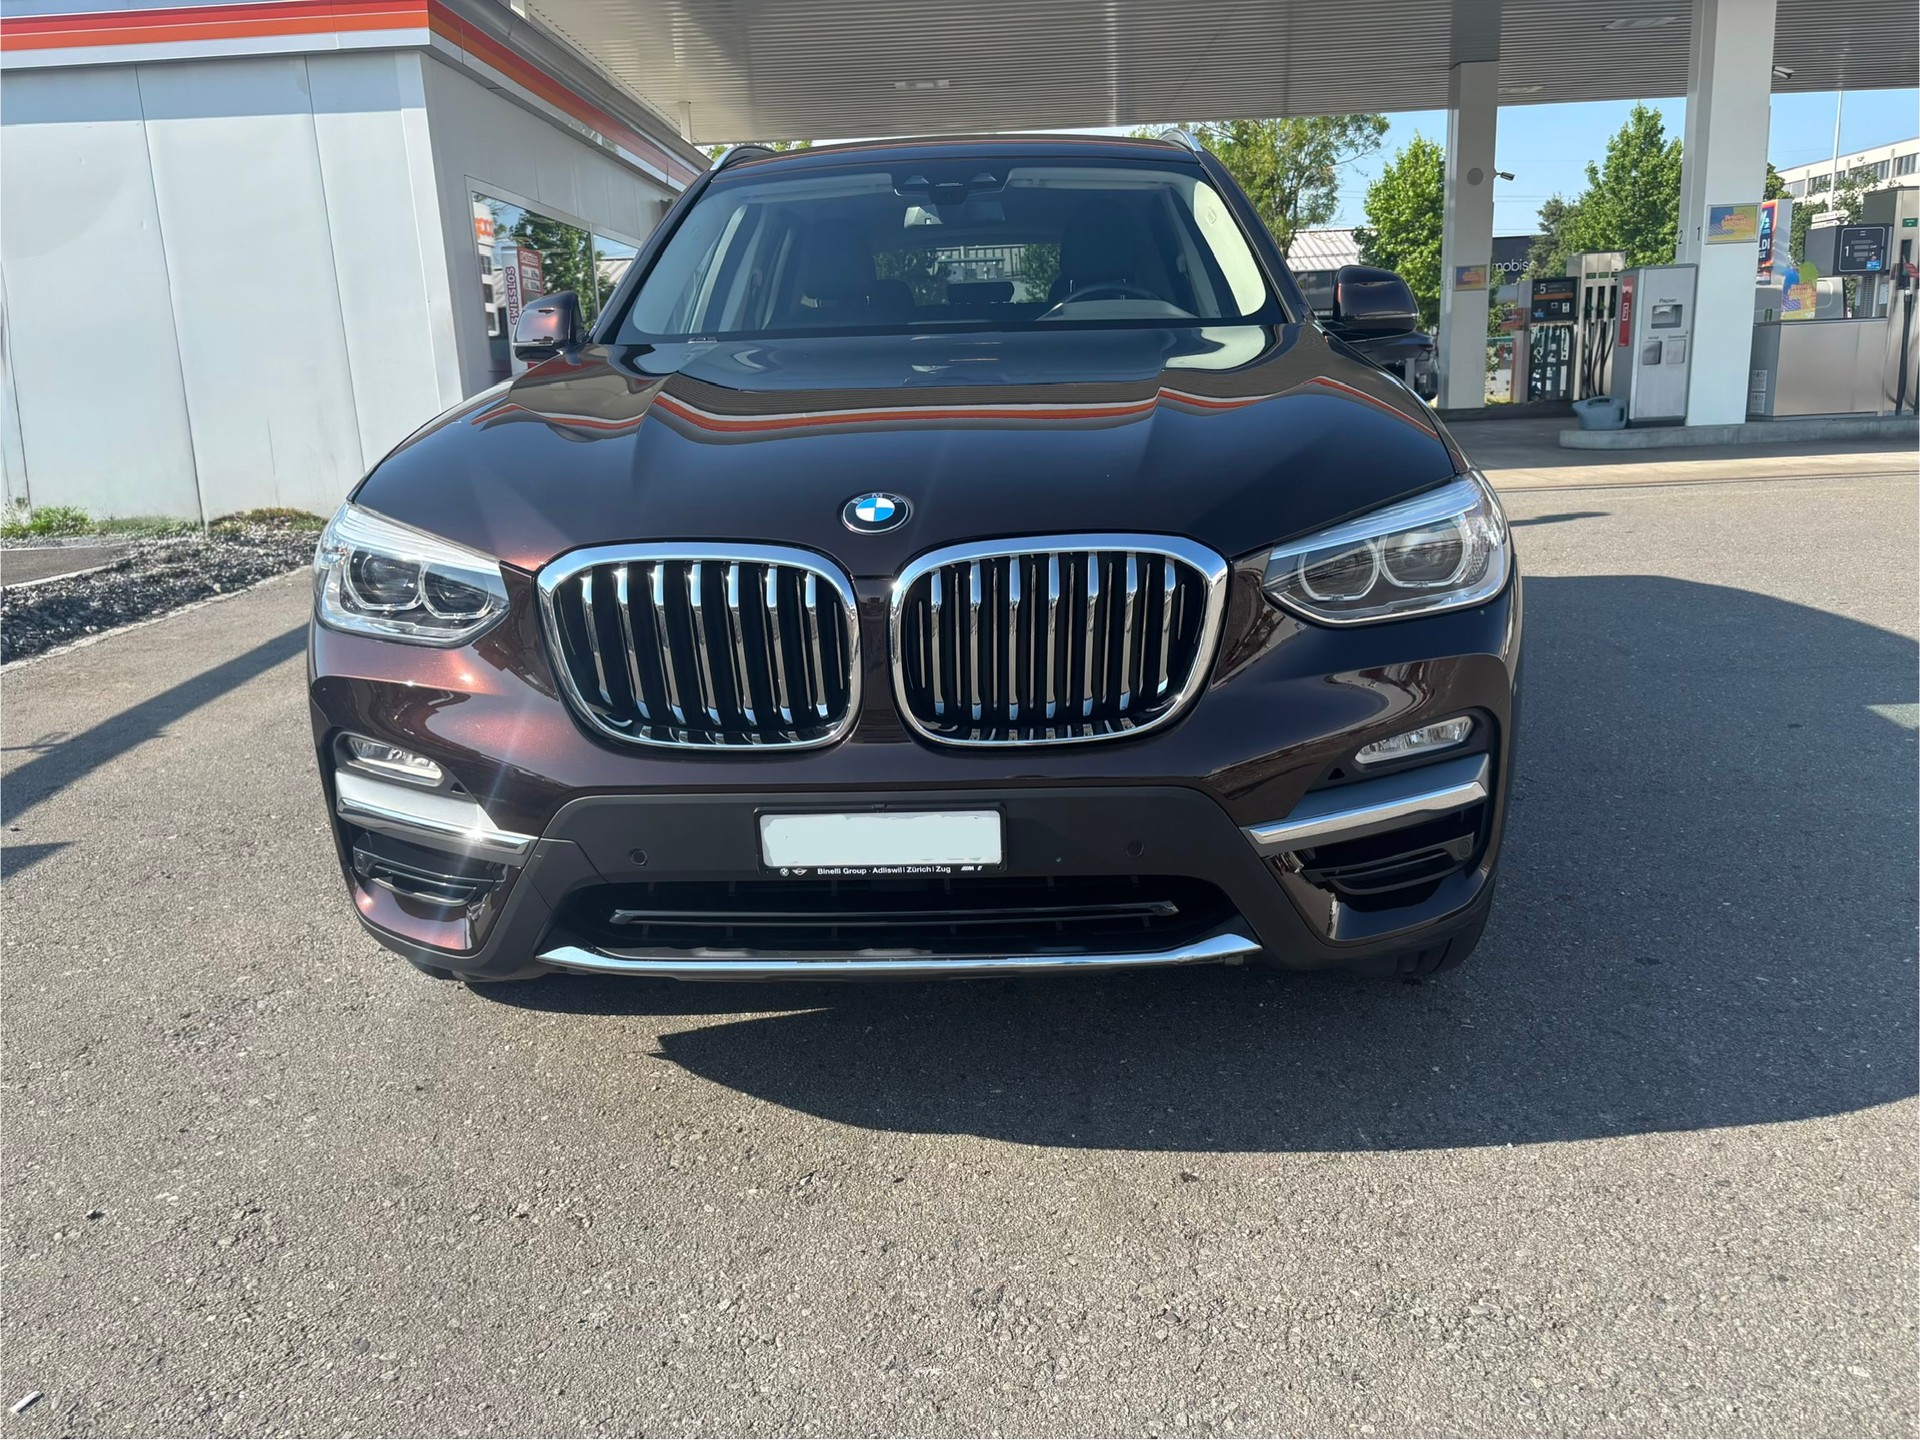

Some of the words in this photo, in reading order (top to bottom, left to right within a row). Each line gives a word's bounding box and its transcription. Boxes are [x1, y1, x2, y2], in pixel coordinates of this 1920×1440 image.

[1678, 229, 1683, 244] 2
[1697, 226, 1701, 241] 1
[1844, 245, 1850, 257] 1
[505, 265, 520, 325] SWISSLOS
[1539, 283, 1547, 294] 5
[817, 867, 841, 875] Binelli
[842, 867, 867, 876] Group
[935, 865, 951, 874] Zug
